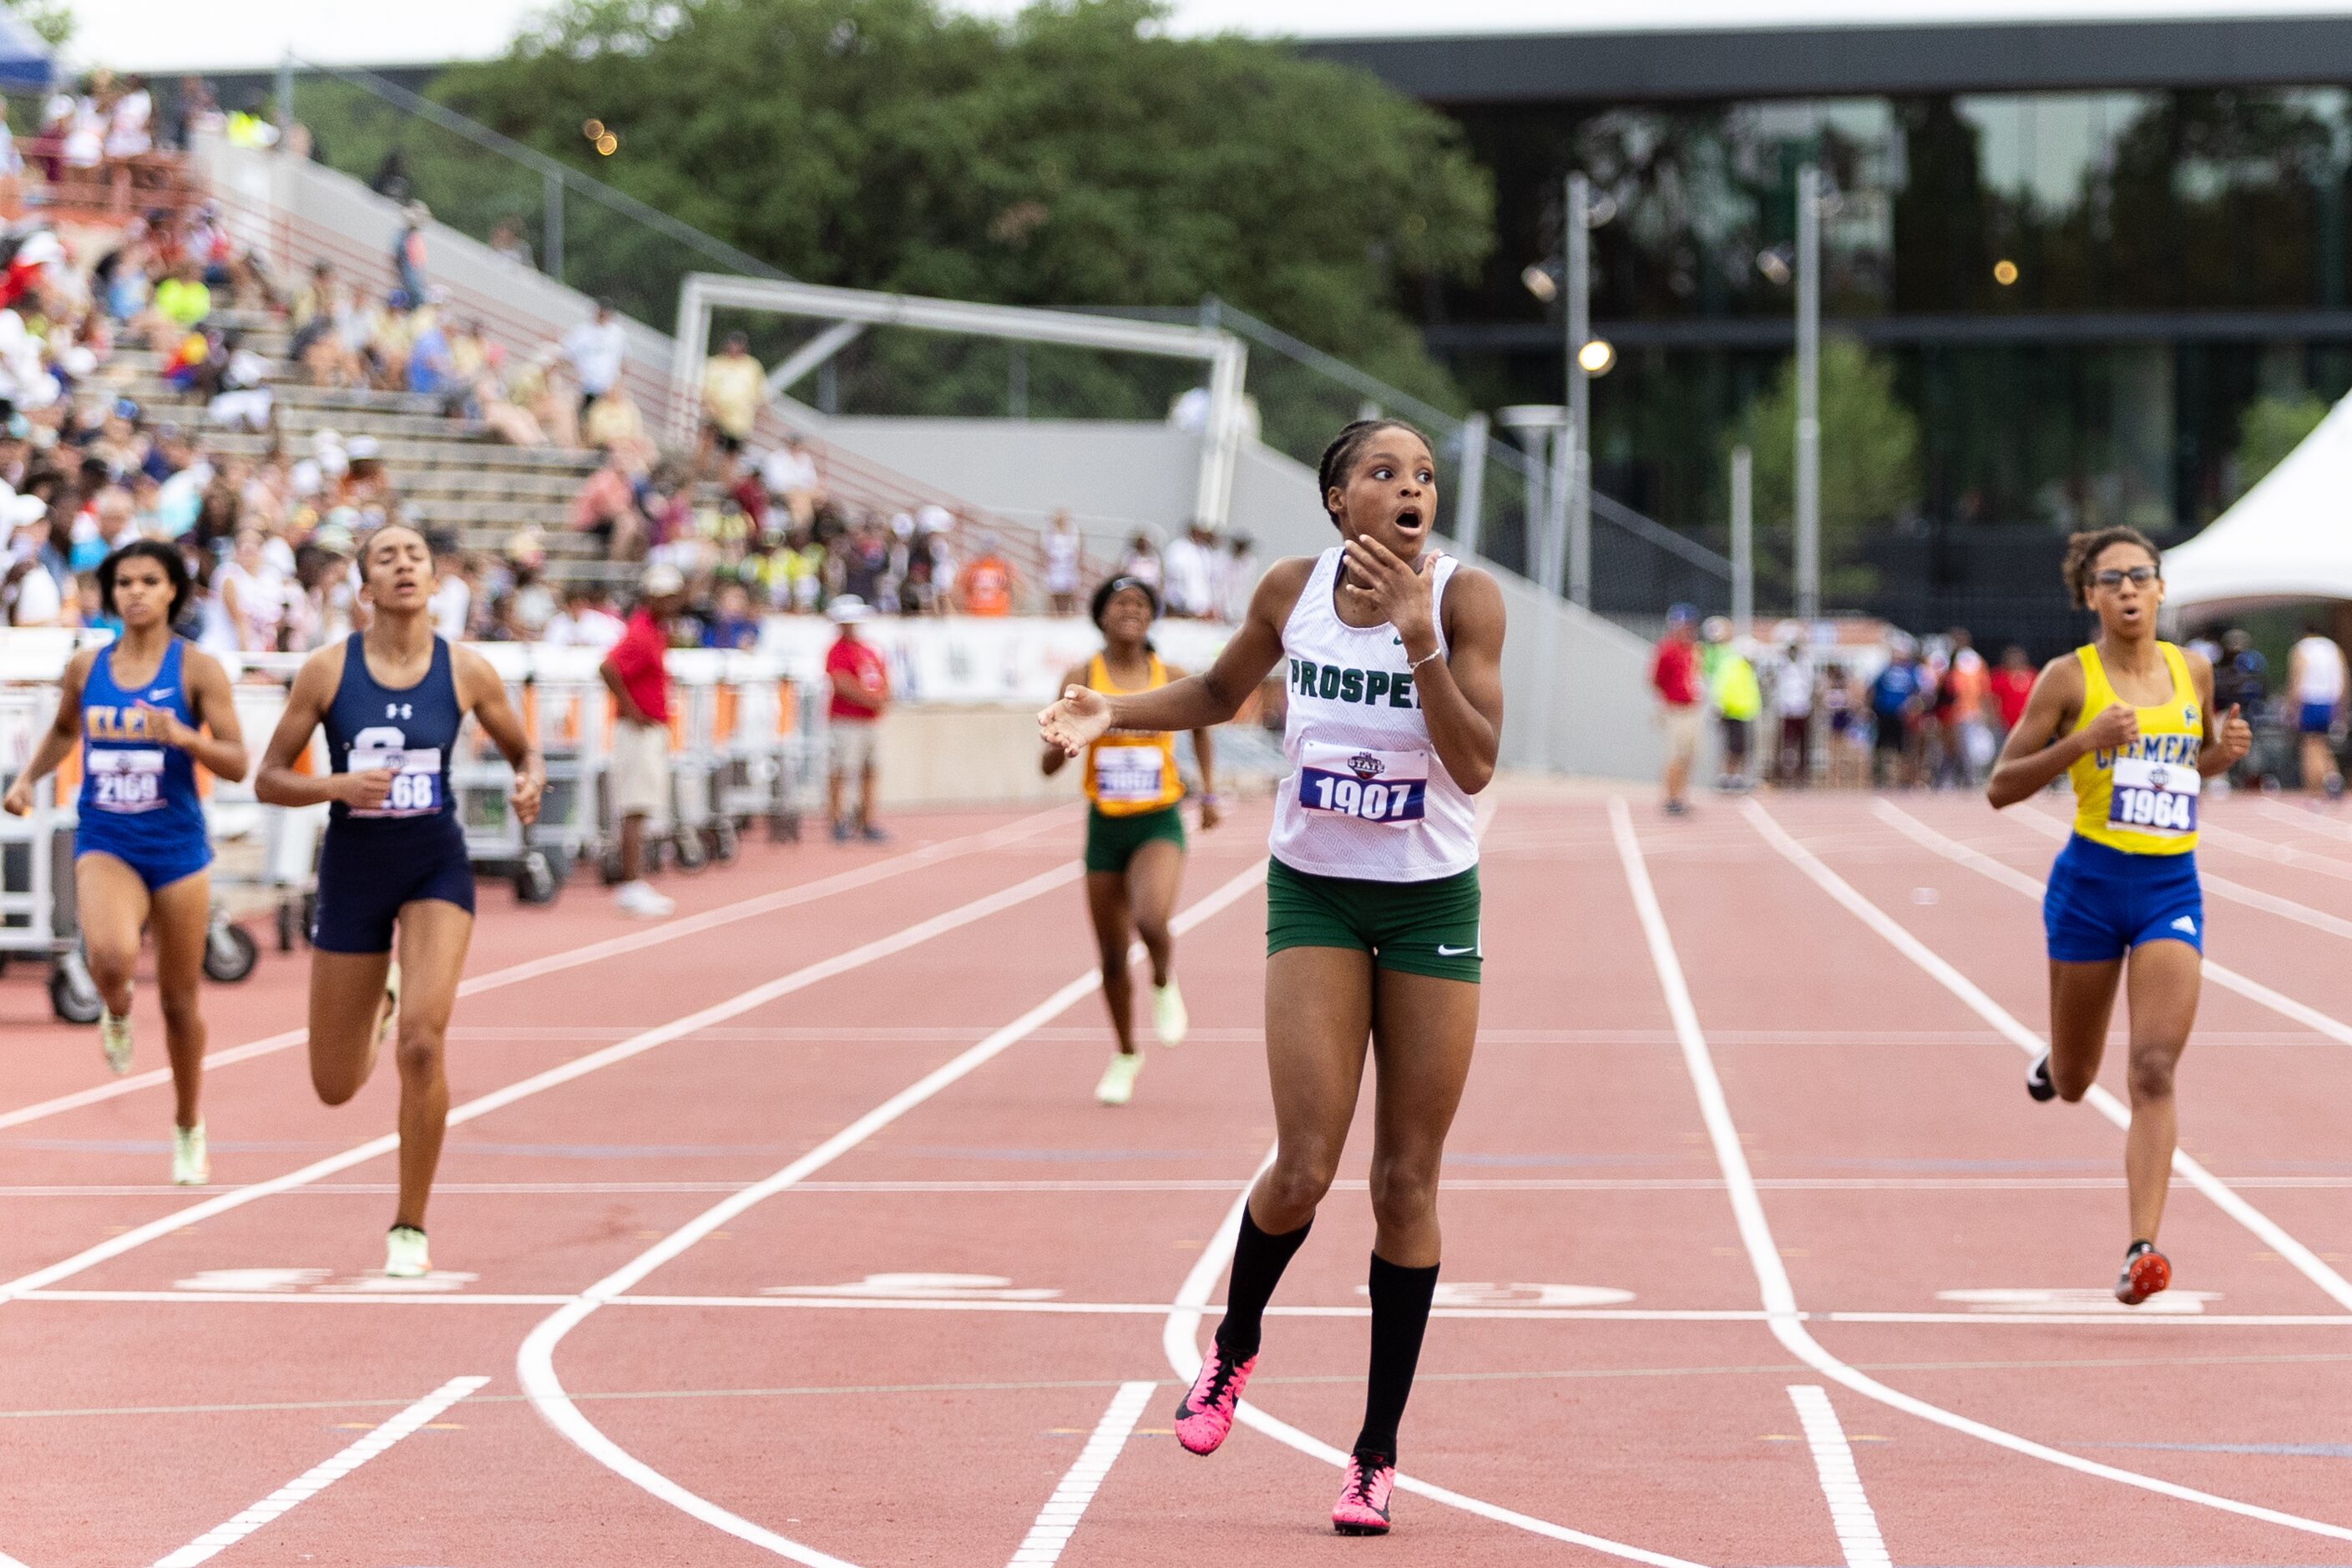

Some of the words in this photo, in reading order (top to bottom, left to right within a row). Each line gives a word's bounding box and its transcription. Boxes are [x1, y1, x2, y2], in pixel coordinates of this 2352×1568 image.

[1290, 658, 1422, 710] PROSPE
[1315, 776, 1412, 820] 1907
[2119, 787, 2191, 830] 1964
